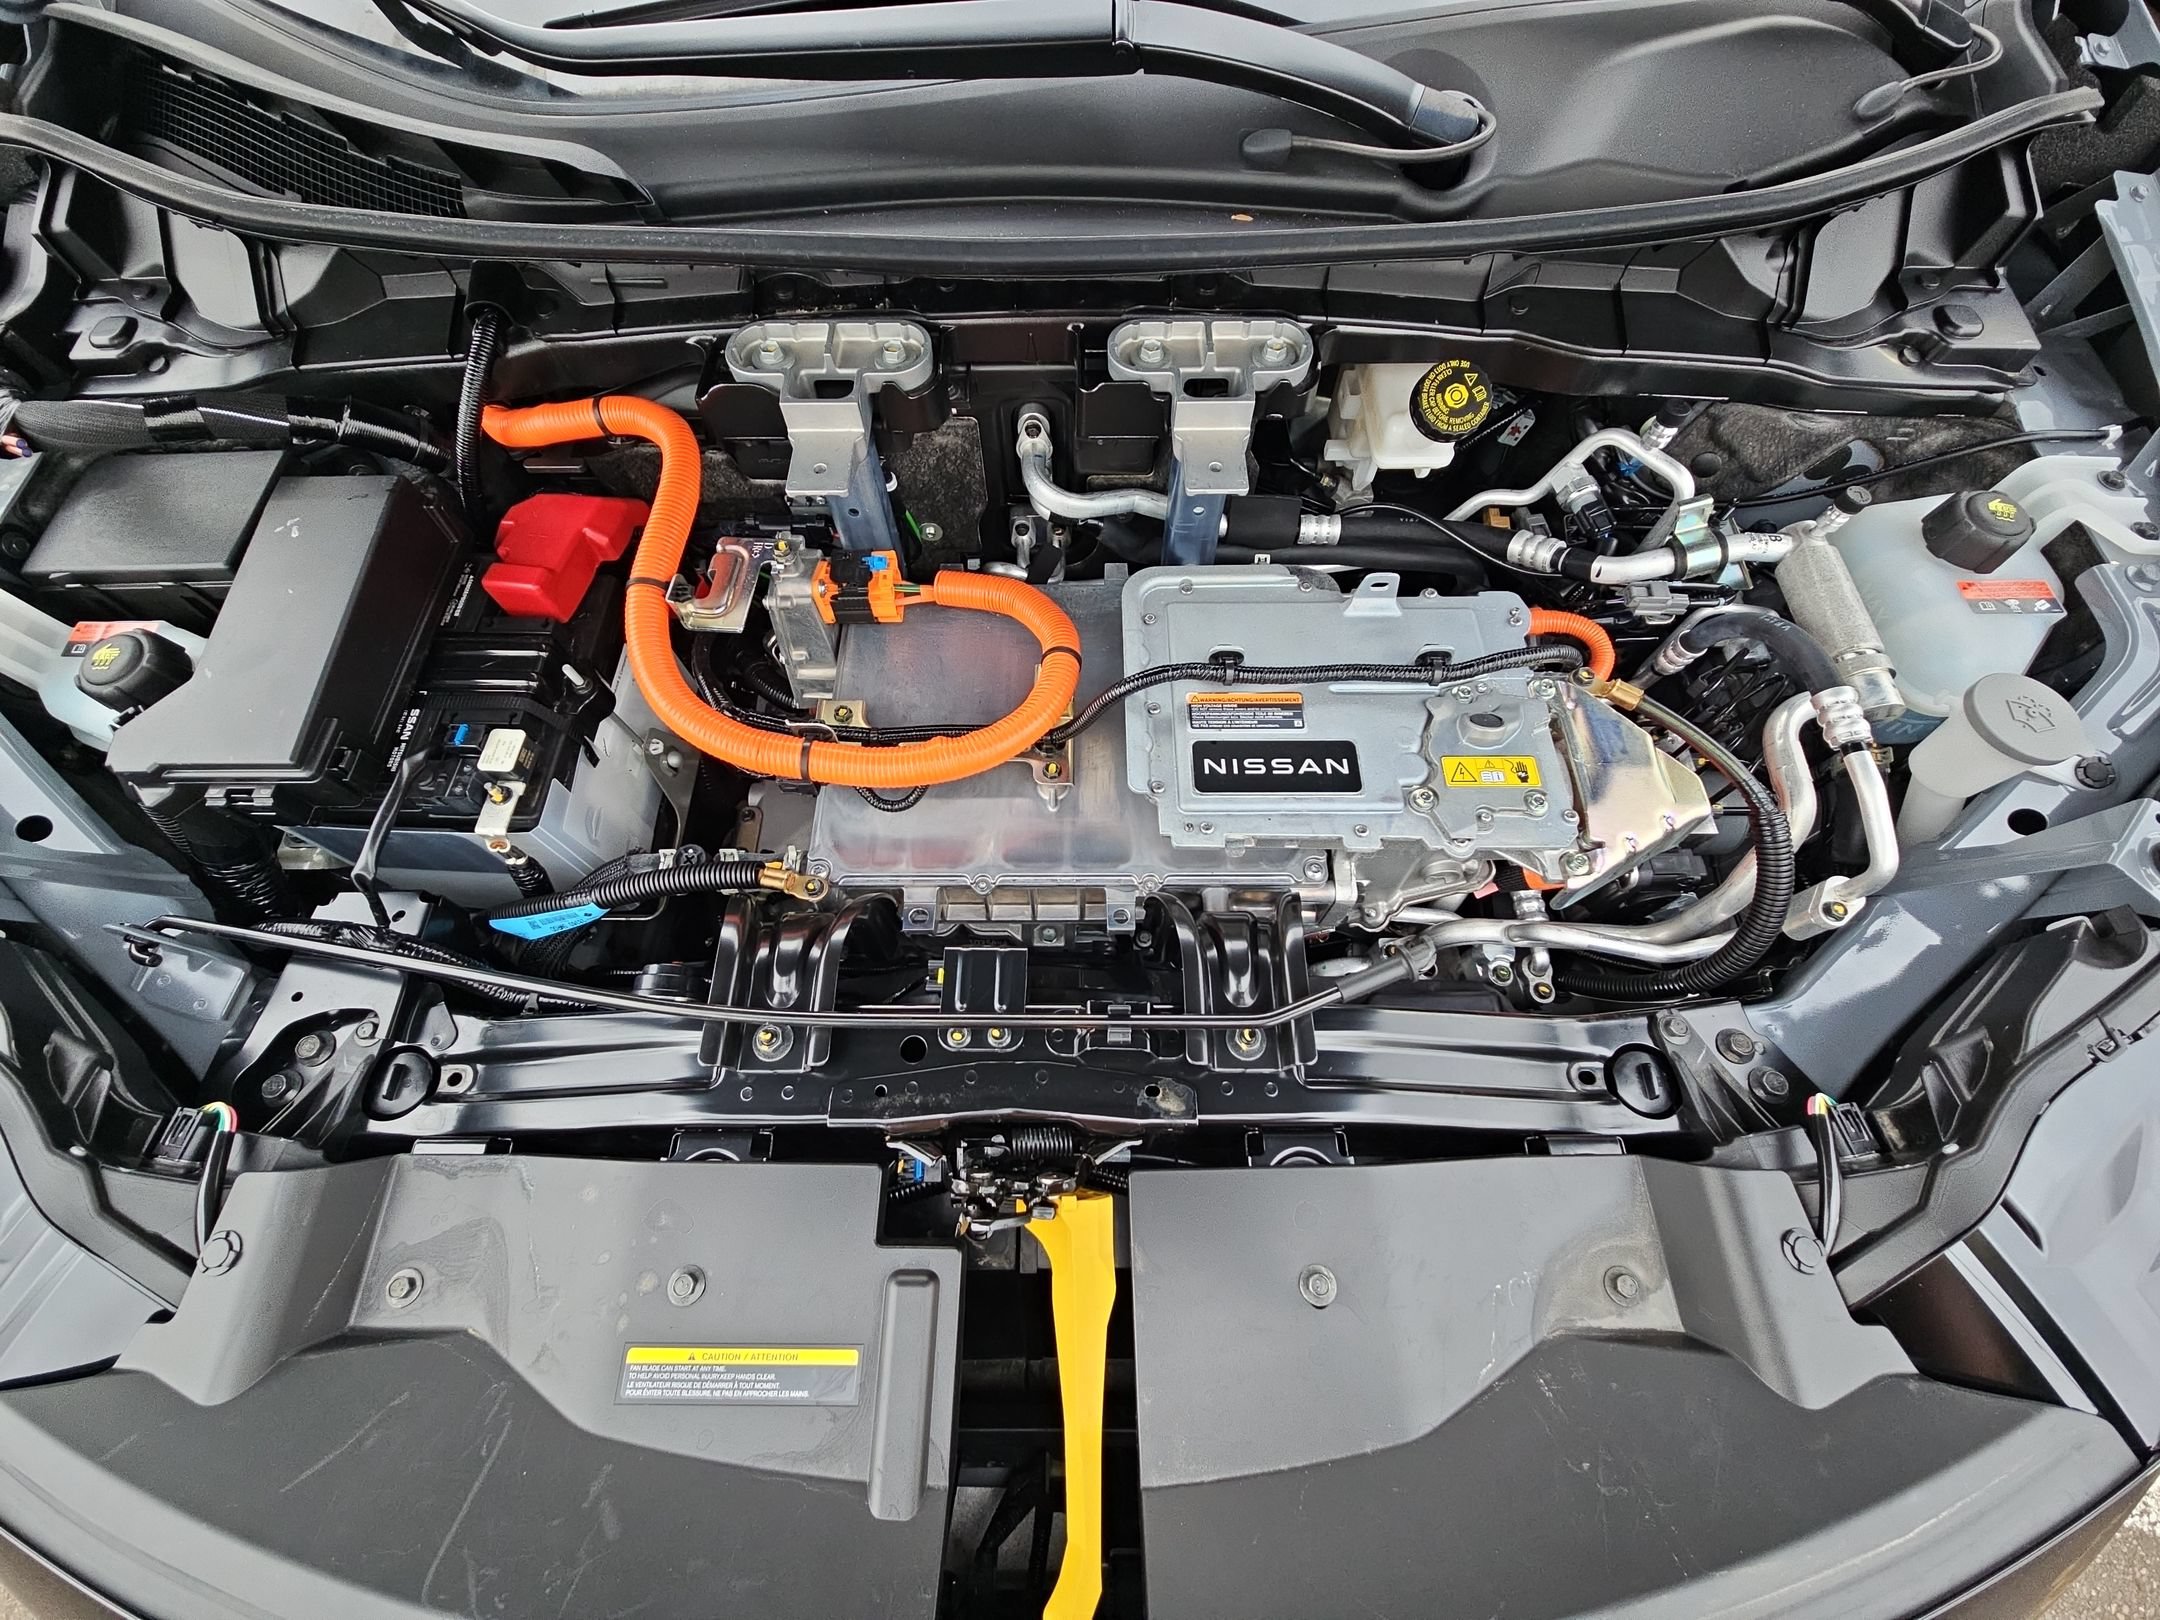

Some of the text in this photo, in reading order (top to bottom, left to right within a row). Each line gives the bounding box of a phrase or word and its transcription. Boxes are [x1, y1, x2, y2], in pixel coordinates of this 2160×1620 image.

[1447, 360, 1459, 368] ONLY
[1460, 360, 1470, 368] USE
[1437, 369, 1452, 381] CLEAN
[1429, 379, 1440, 397] FILLER
[1421, 393, 1429, 409] BRAKE
[1436, 393, 1450, 414] WARNING
[1425, 409, 1436, 423] FLUID
[1432, 407, 1449, 423] BEFORE
[1450, 412, 1474, 424] REMOVING
[1471, 402, 1489, 426] CONTAINER
[1435, 420, 1448, 430] FROM
[1453, 423, 1471, 432] SEALED
[1203, 758, 1350, 775] NISSAN
[702, 1353, 741, 1361] CAUTION
[751, 1353, 799, 1361] ATTENTION
[643, 1388, 662, 1396] ÉVITER
